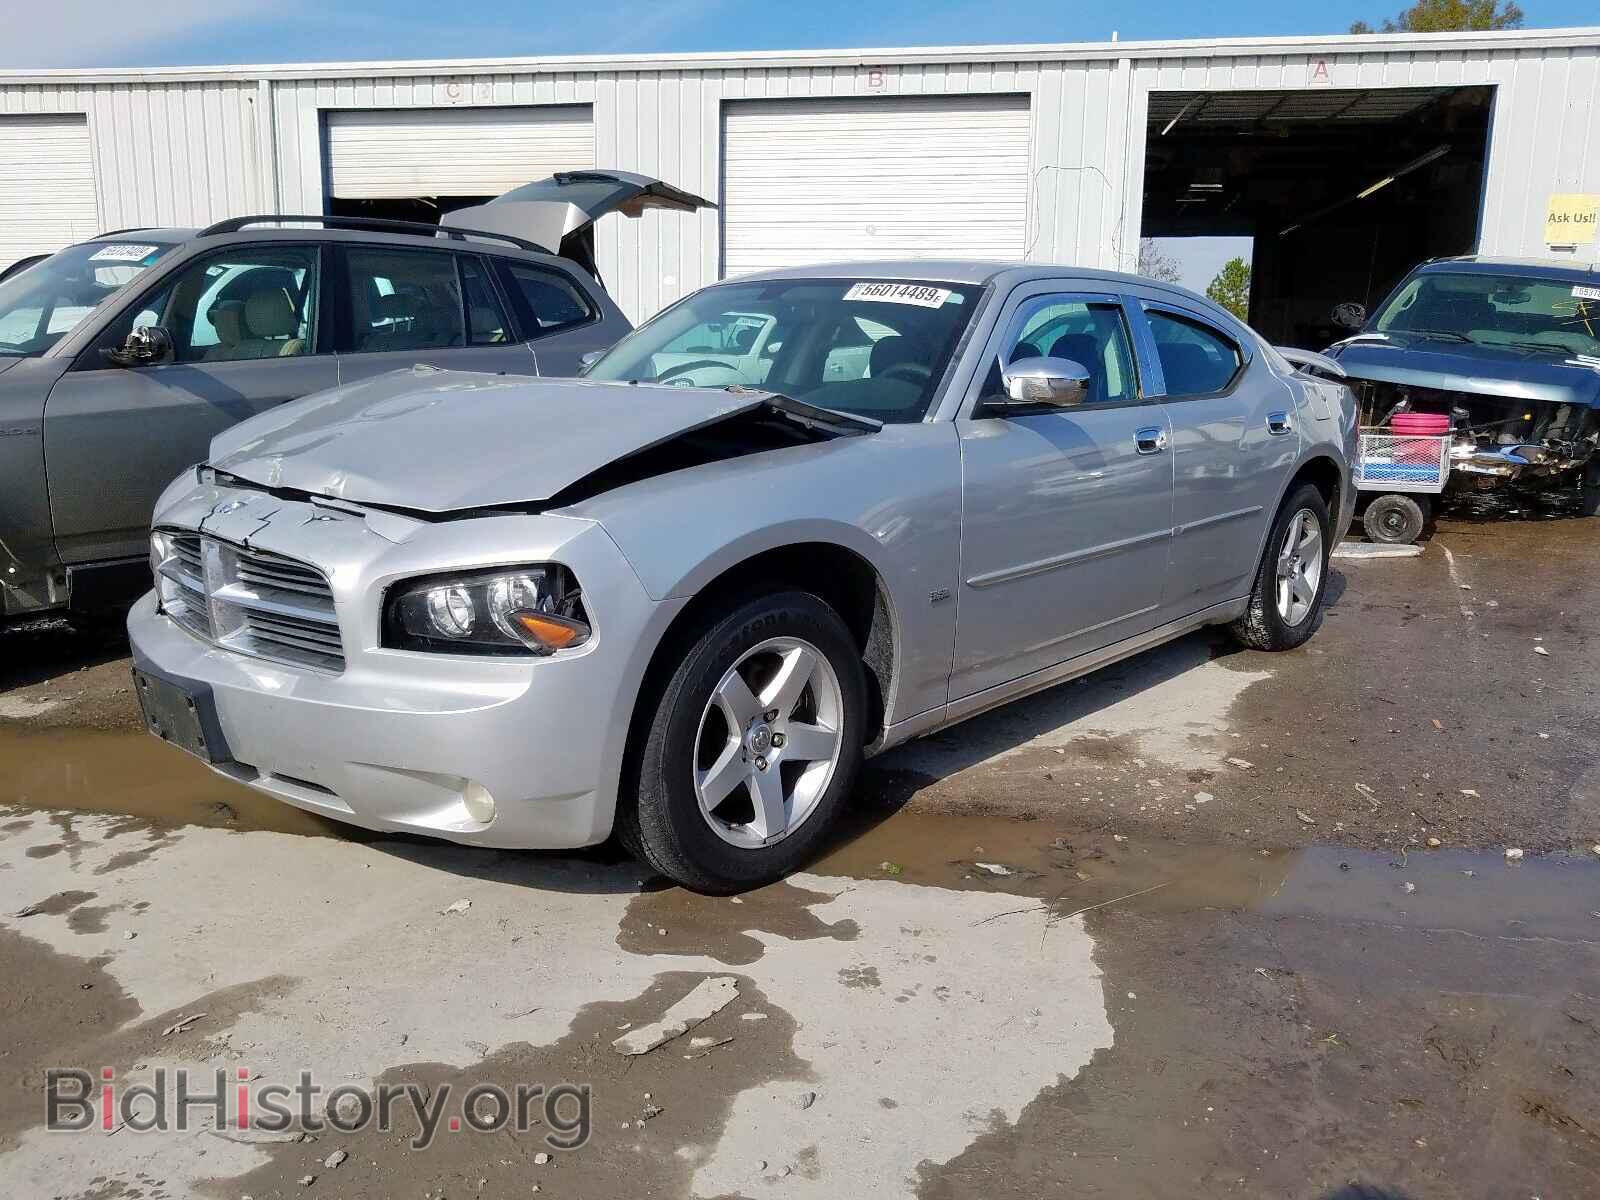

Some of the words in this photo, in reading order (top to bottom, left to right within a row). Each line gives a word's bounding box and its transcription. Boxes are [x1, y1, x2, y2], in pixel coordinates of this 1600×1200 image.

[1313, 61, 1328, 79] A
[868, 71, 884, 88] B
[446, 82, 461, 99] C
[1548, 212, 1570, 223] Ask
[1573, 212, 1596, 223] Us!!
